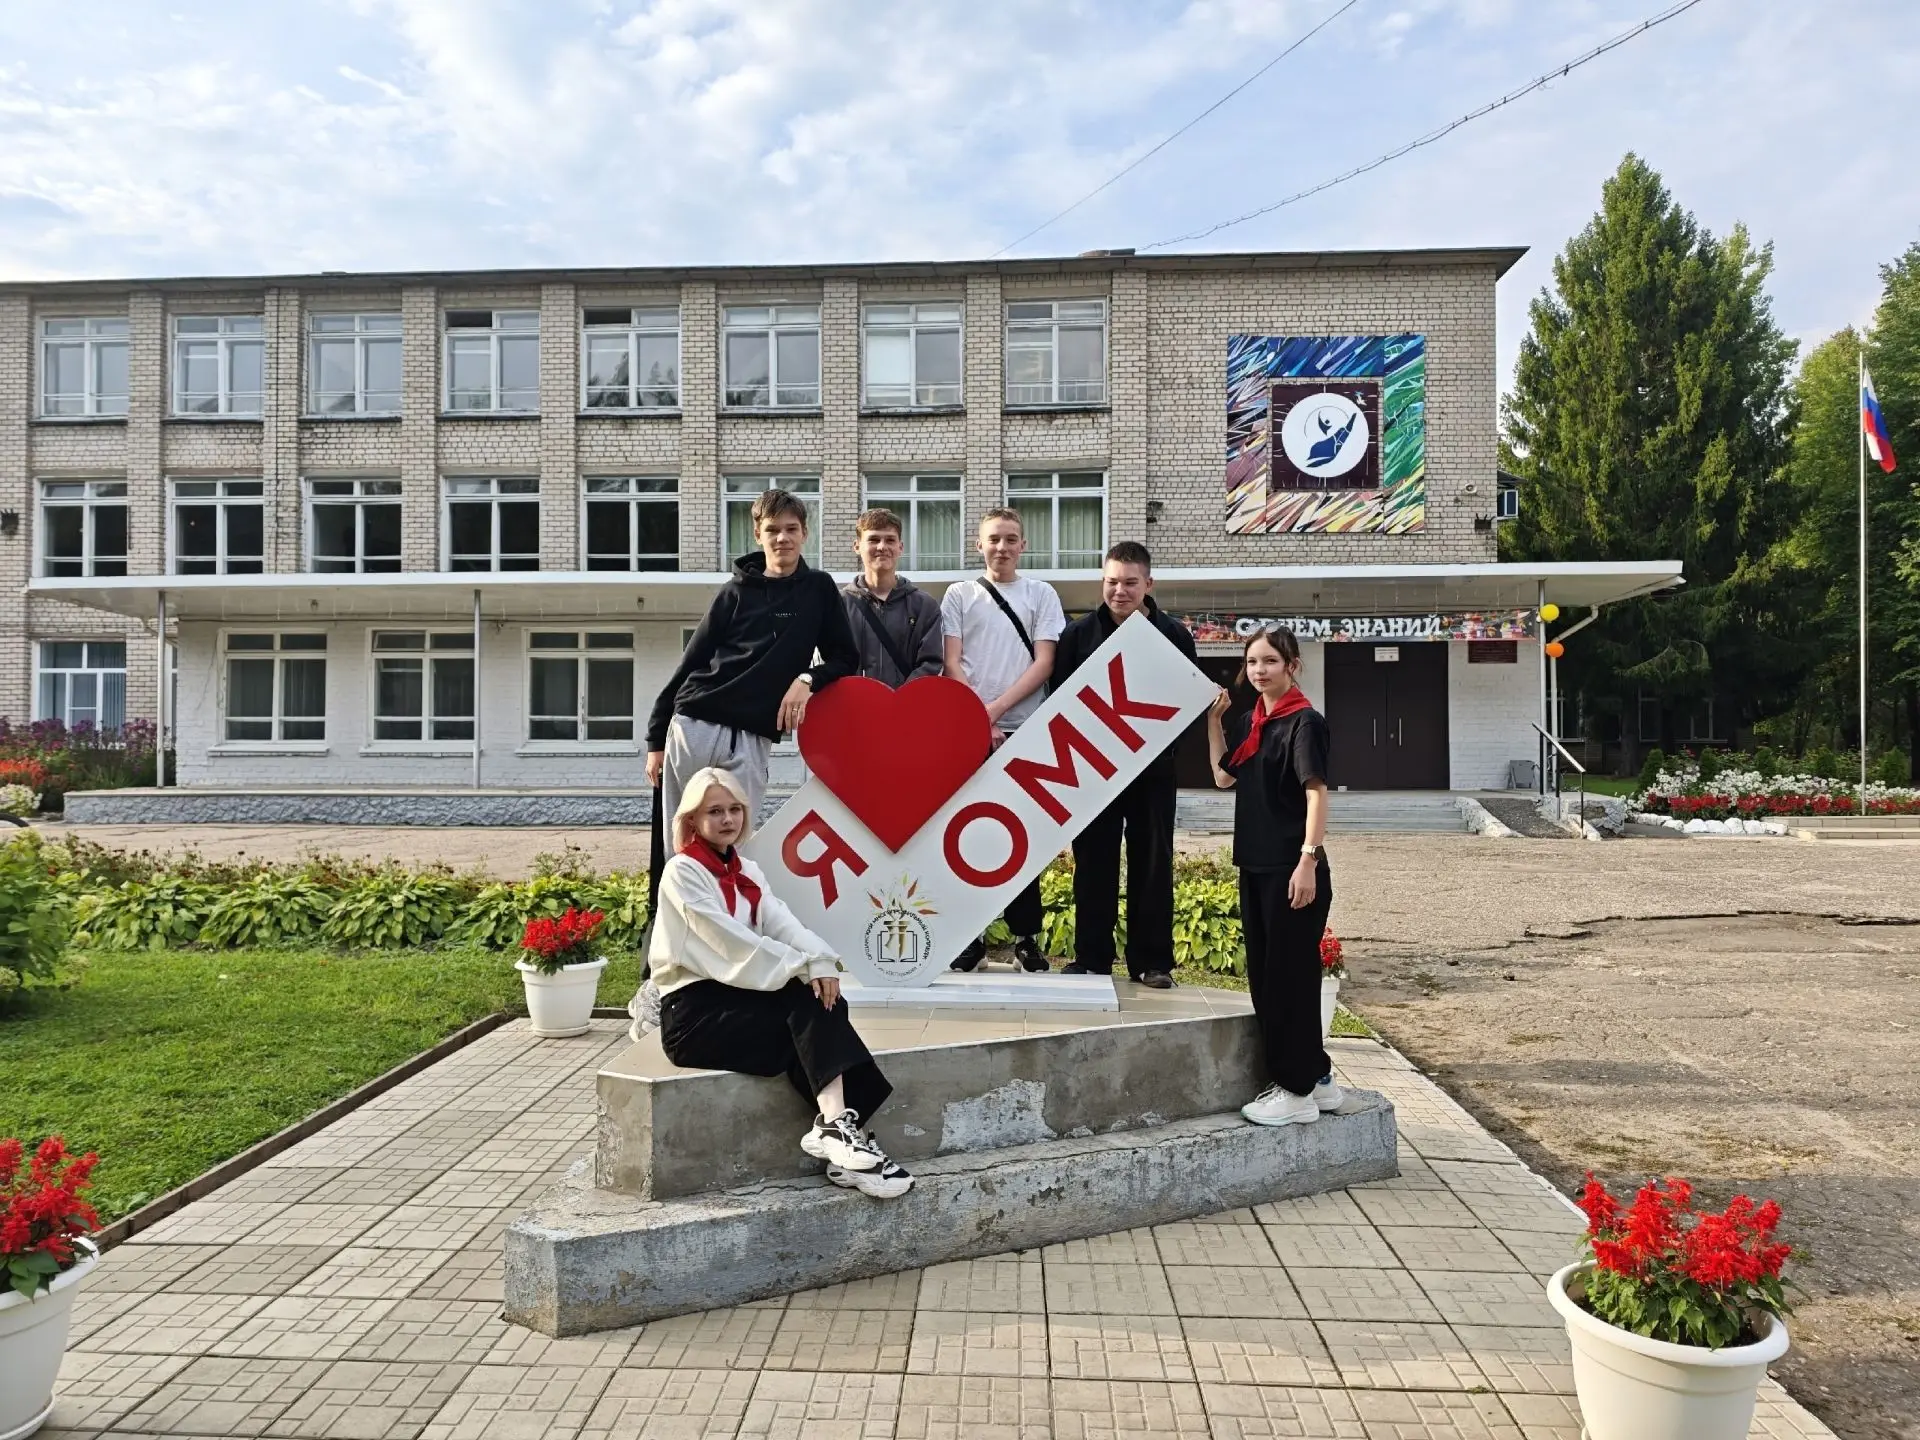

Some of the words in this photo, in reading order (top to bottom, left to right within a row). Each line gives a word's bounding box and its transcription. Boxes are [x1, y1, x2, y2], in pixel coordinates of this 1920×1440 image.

[1235, 617, 1257, 637] С
[1340, 614, 1442, 637] ЗНАНИЙ
[782, 810, 869, 909] Я
[943, 652, 1181, 887] ОМК
